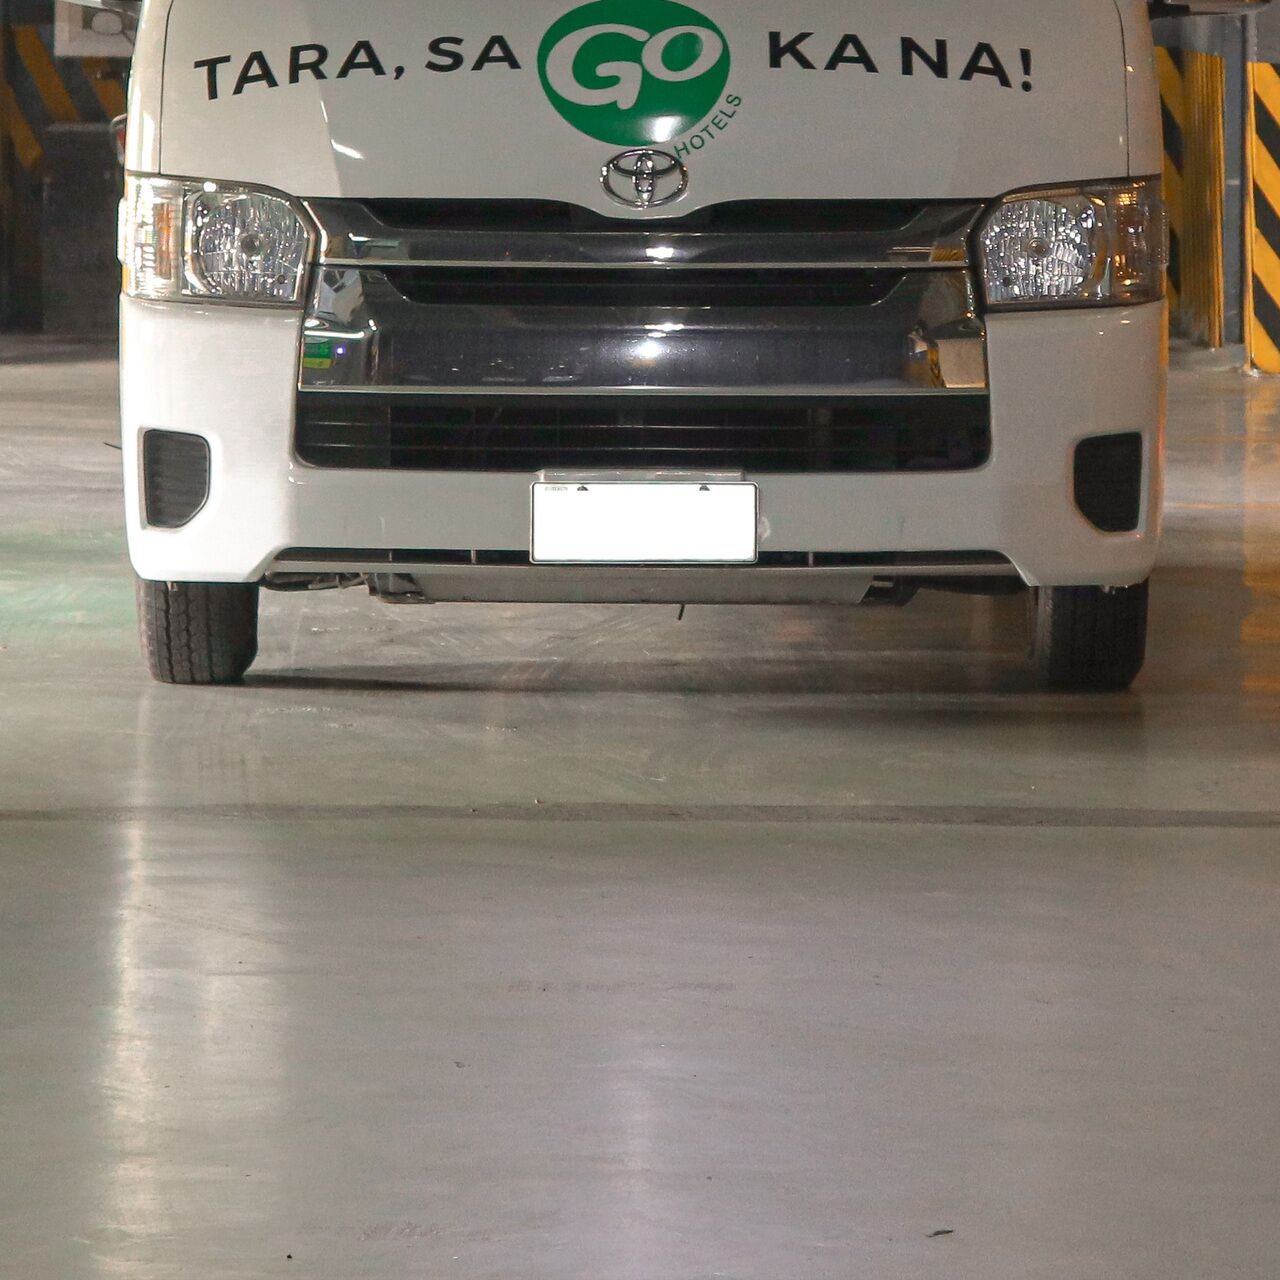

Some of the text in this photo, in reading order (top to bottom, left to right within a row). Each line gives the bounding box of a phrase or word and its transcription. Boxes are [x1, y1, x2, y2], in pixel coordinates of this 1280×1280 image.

[193, 23, 1033, 110] TARA, SA GO KANA!
[673, 93, 742, 159] HOTELS
